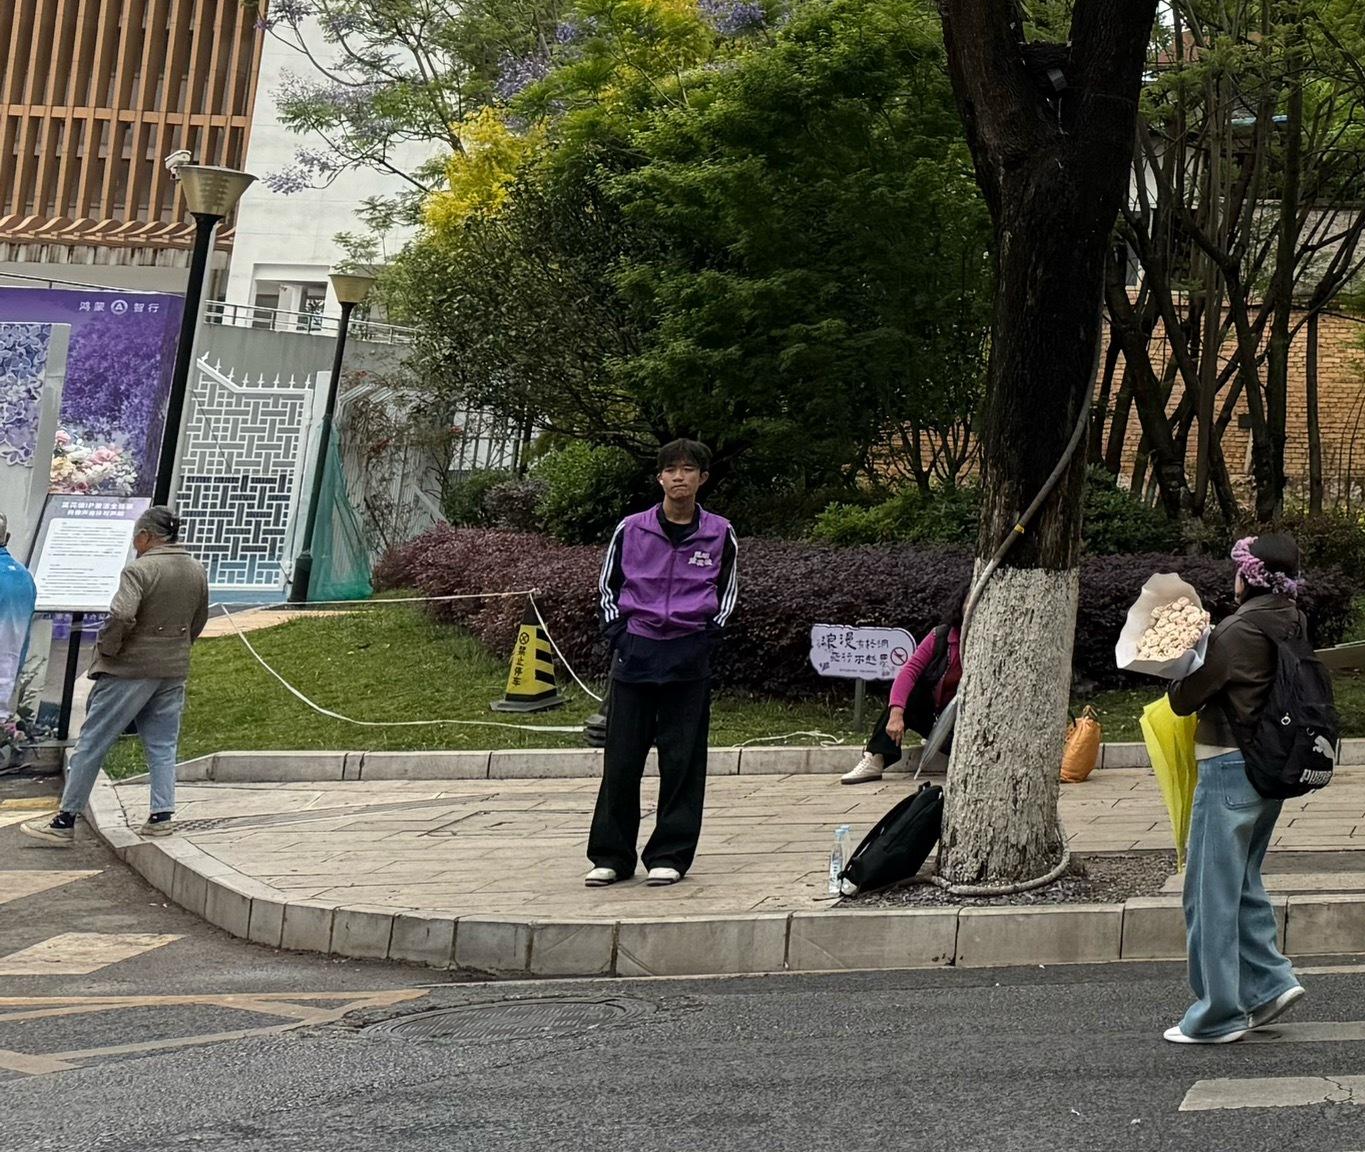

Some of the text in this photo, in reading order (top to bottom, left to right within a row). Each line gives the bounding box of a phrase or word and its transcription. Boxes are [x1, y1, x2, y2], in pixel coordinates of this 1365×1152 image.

[79, 300, 160, 313] 鸿蒙 智行
[511, 645, 526, 687] 禁止停车
